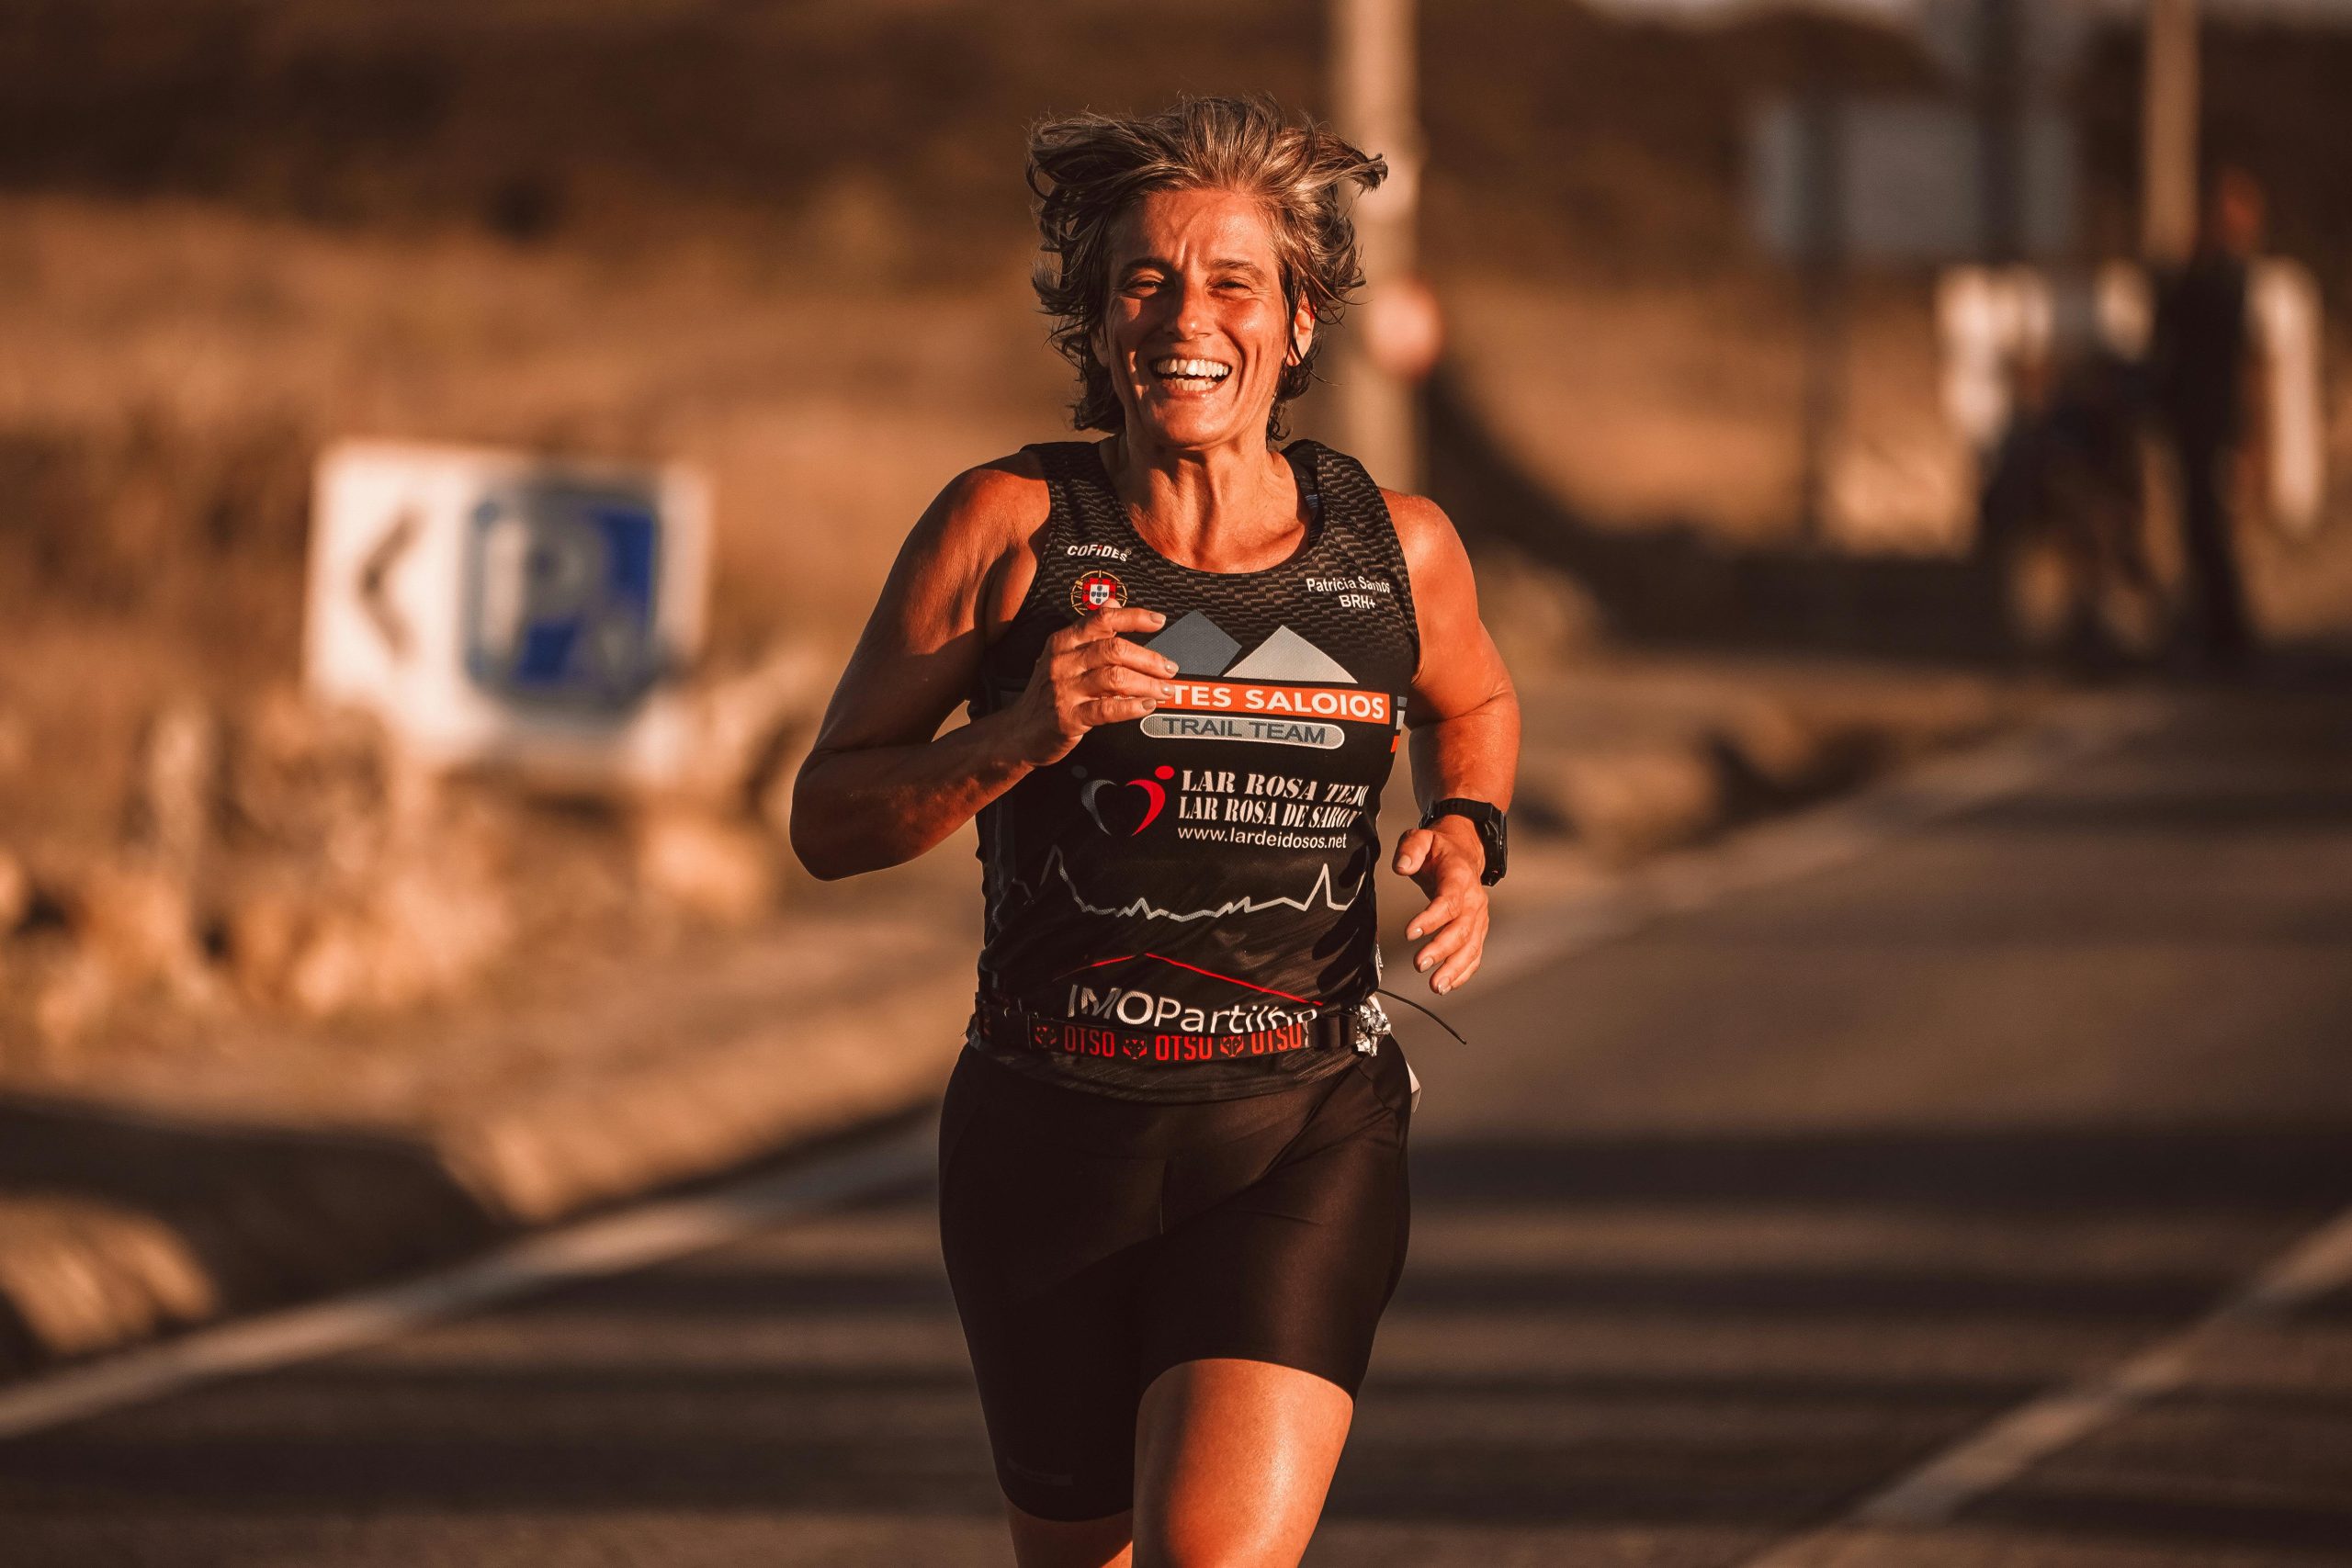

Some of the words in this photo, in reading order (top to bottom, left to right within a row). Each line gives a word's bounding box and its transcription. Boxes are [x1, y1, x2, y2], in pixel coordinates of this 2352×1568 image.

[1306, 578, 1357, 592] Patricia
[1339, 594, 1376, 609] BRH+
[1158, 684, 1232, 708] TES
[1245, 689, 1385, 719] SALOIOS
[1162, 717, 1242, 738] TRAIL
[1249, 722, 1326, 745] TEAM
[1182, 770, 1236, 794] LAR
[1244, 773, 1317, 801] ROSA
[1323, 784, 1370, 807] TEJO
[1178, 796, 1218, 821] LAR
[1224, 798, 1277, 826] ROSA
[1281, 803, 1310, 828] DE
[1177, 827, 1347, 849] www.lardeidosos.net
[1064, 1025, 1114, 1057] OTSO
